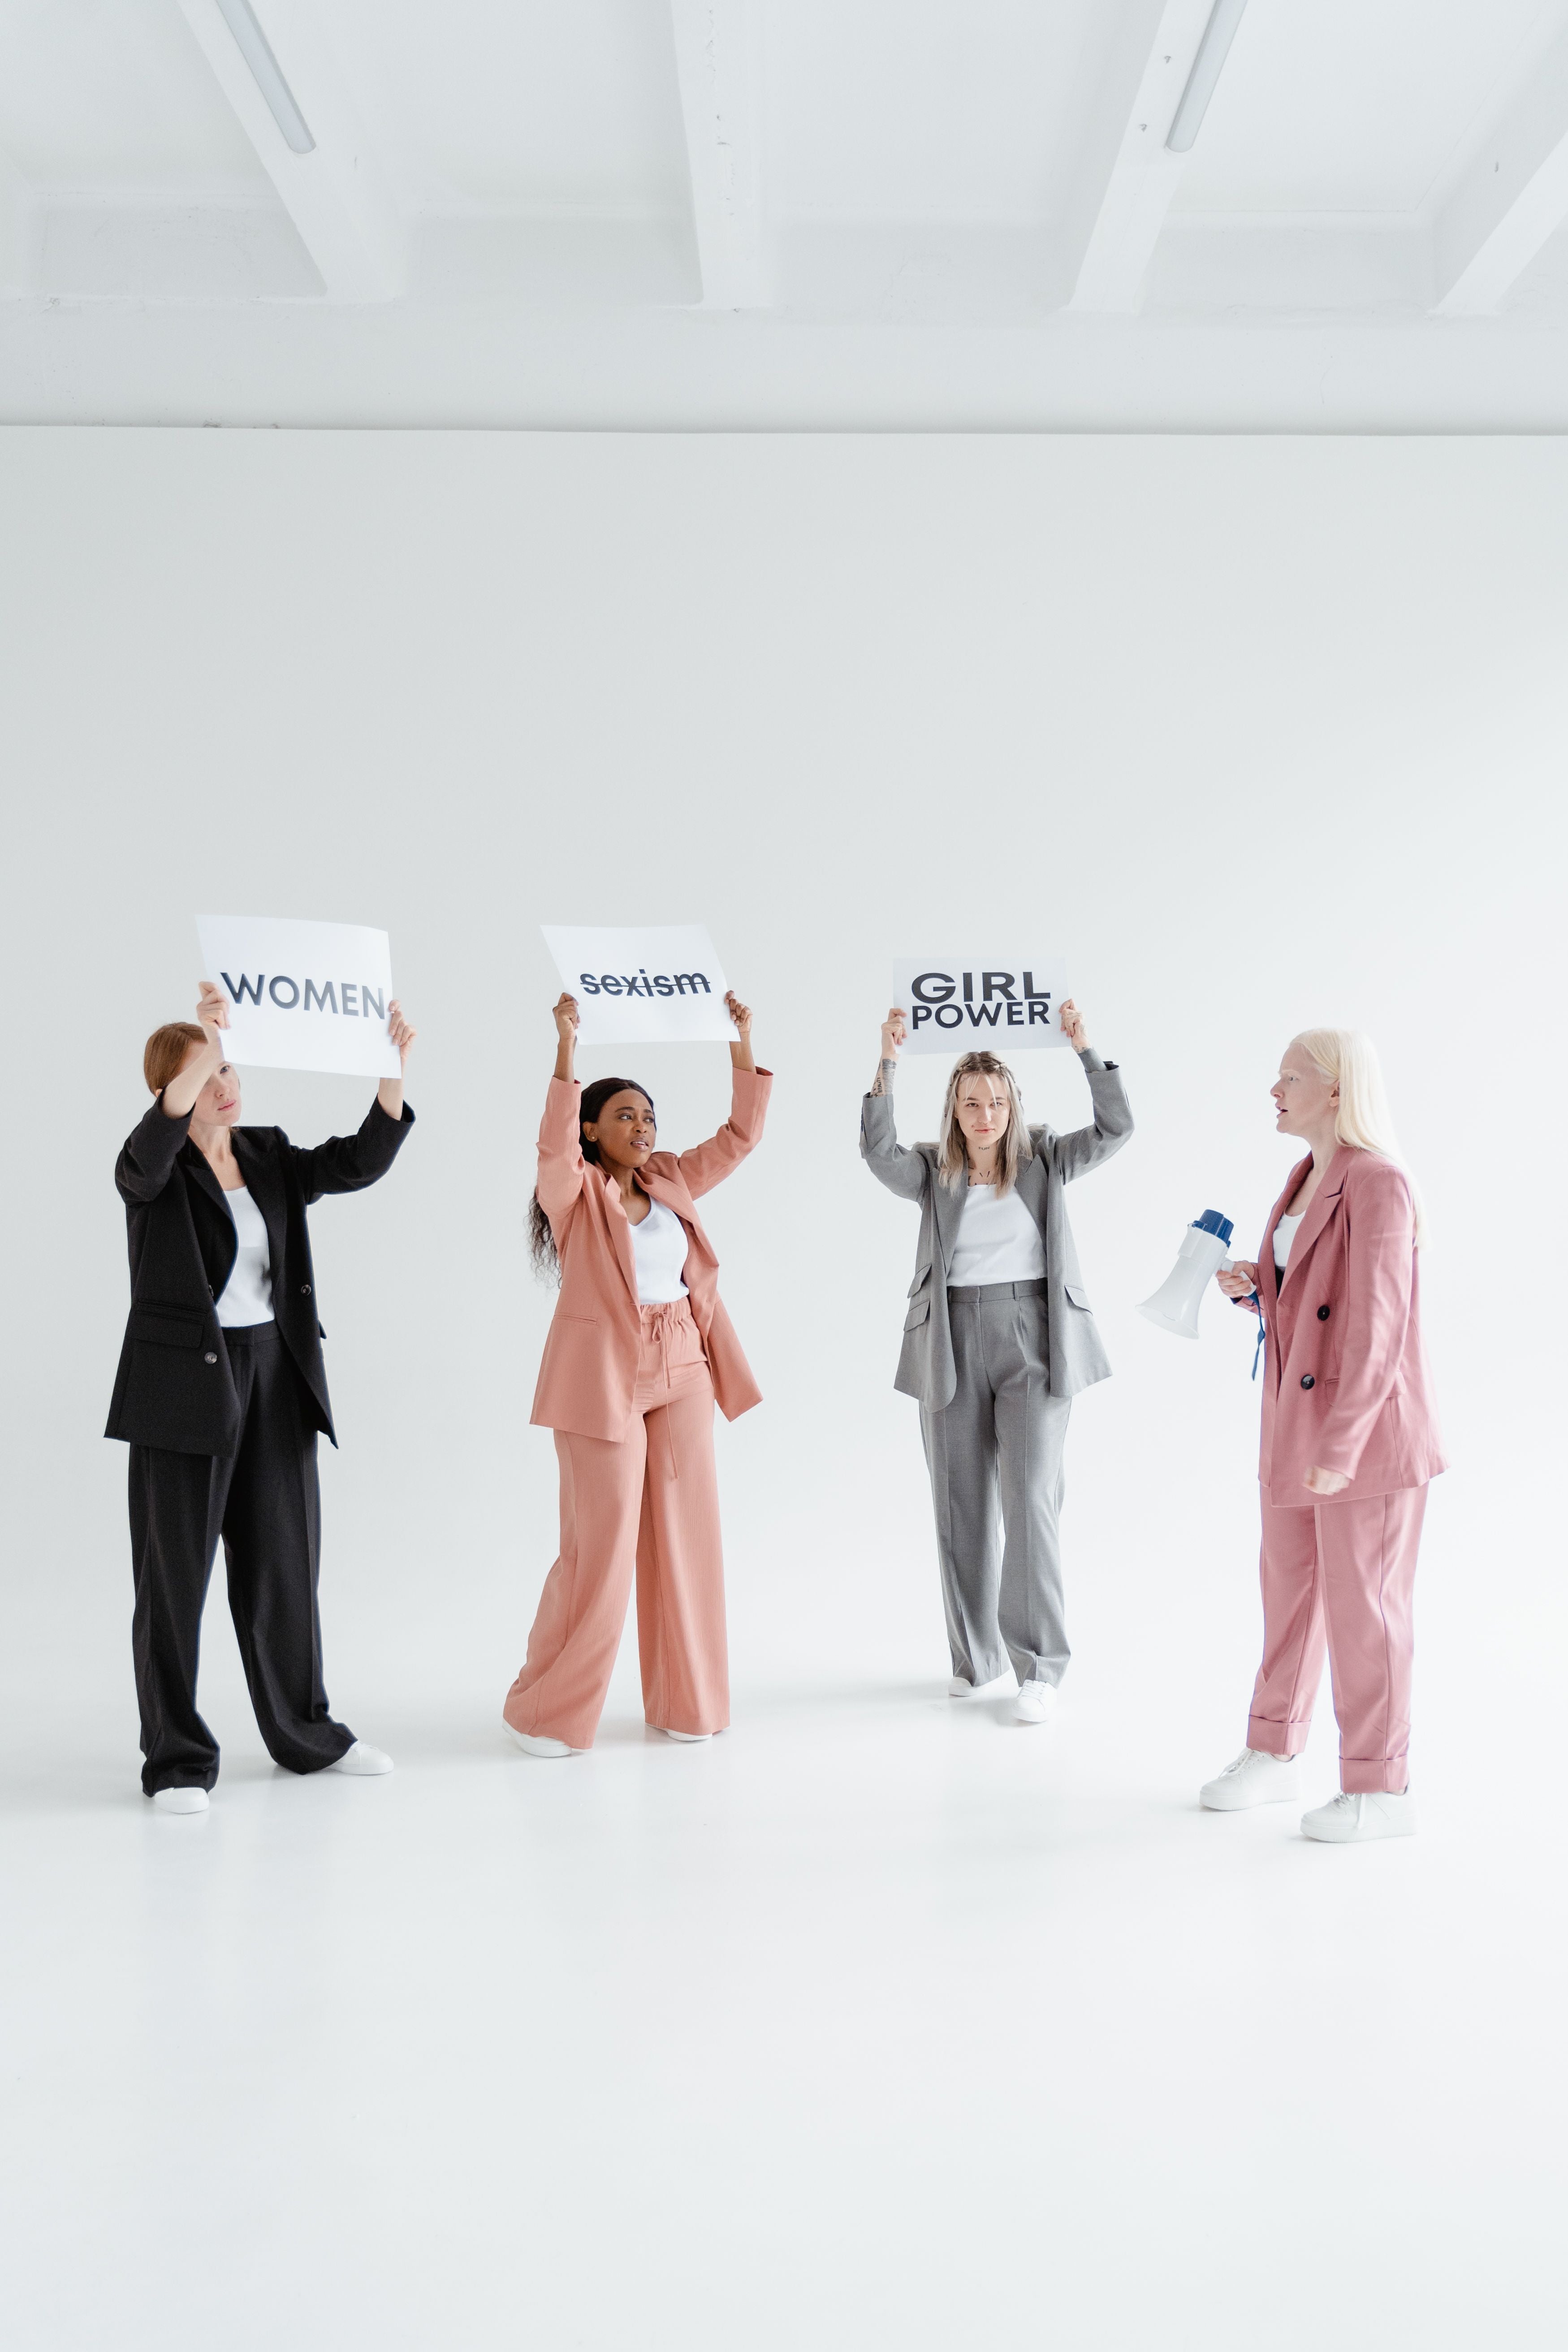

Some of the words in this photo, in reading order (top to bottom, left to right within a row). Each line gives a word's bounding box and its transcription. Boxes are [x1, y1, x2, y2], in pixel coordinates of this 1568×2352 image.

[220, 972, 385, 1020] WOMEN
[580, 969, 712, 997] sexism
[911, 972, 1051, 1004] GIRL
[912, 1001, 1051, 1030] POWER
